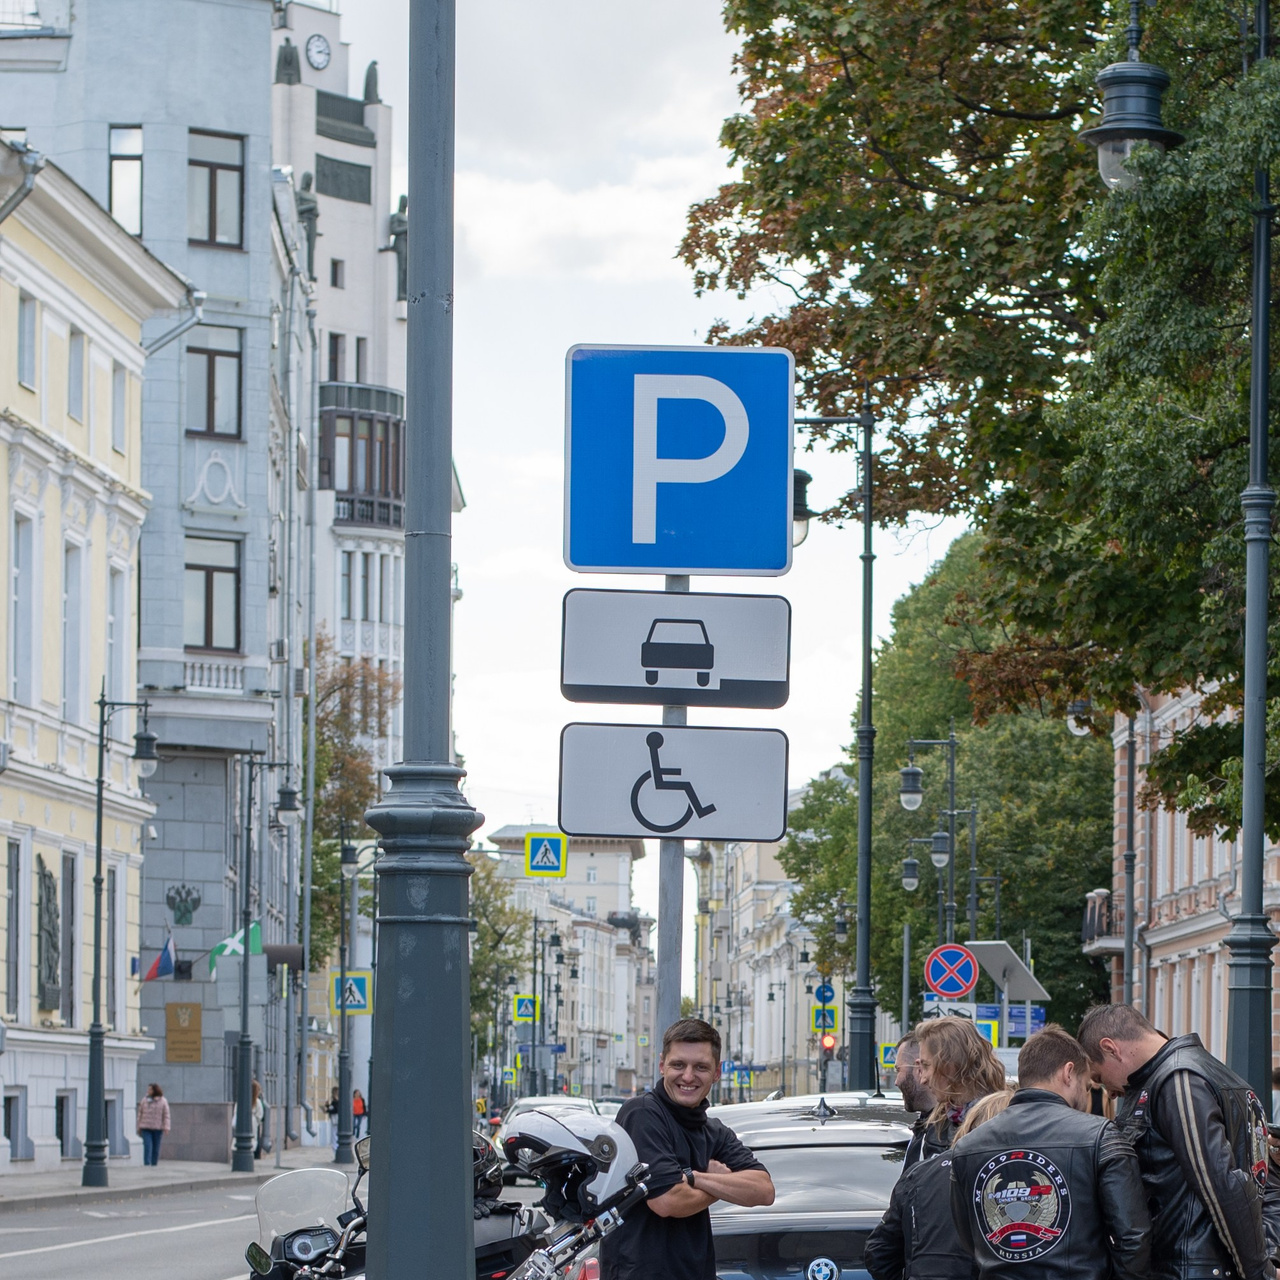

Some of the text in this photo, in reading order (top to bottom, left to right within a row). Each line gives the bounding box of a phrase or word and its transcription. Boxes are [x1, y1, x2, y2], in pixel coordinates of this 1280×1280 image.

[632, 373, 750, 544] P
[987, 1184, 1053, 1199] M109R
[999, 1247, 1043, 1259] RUSSIA
